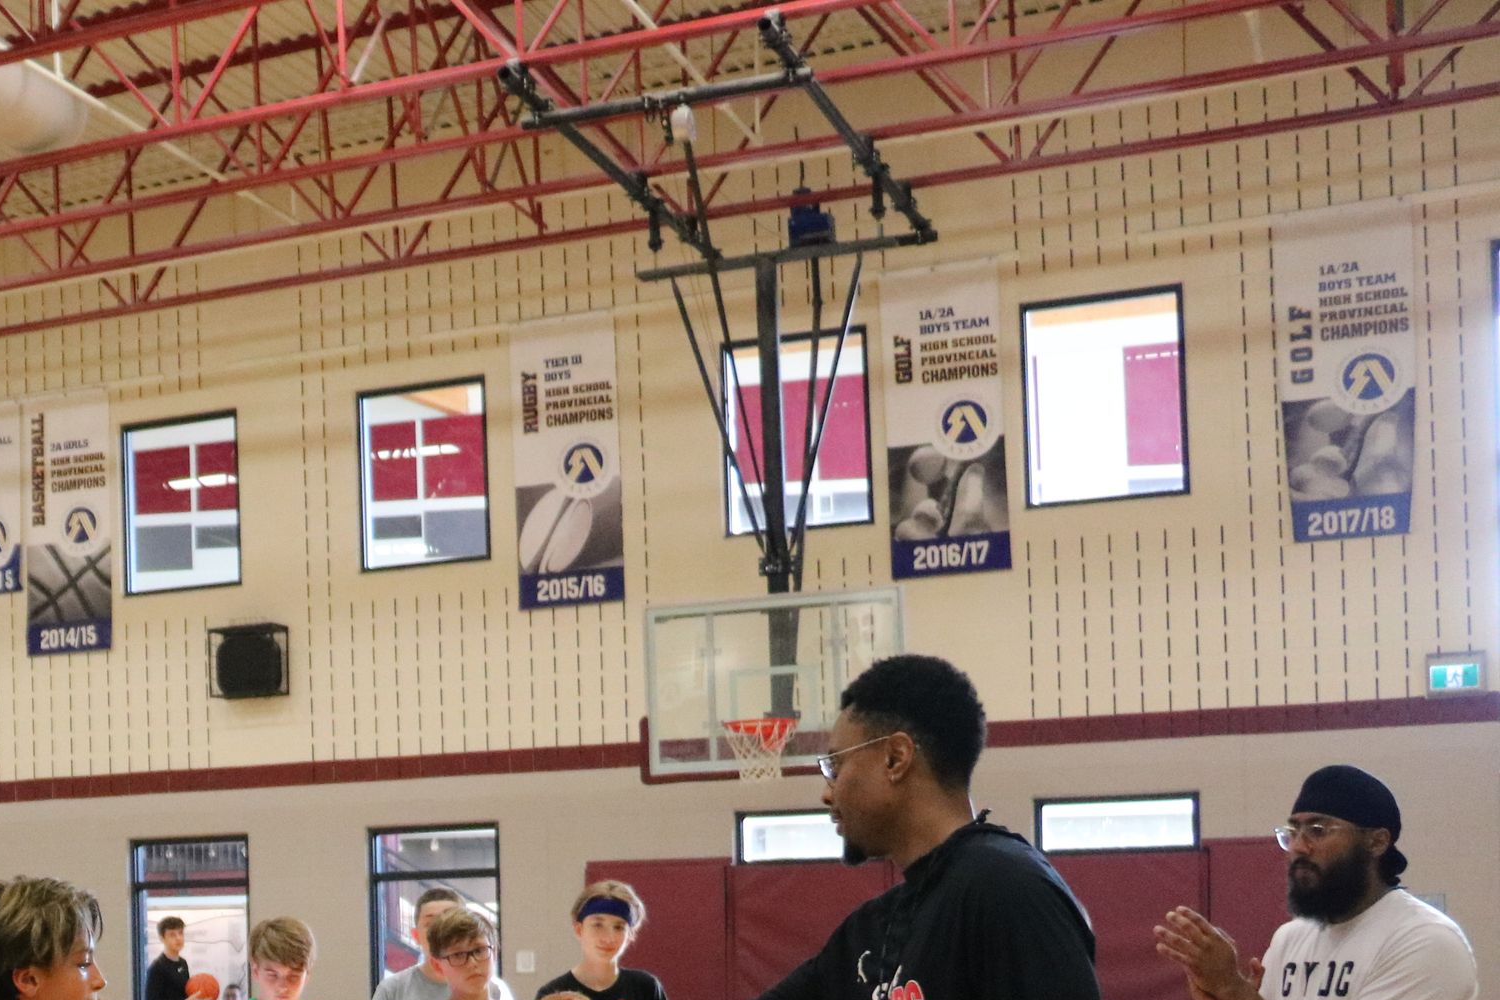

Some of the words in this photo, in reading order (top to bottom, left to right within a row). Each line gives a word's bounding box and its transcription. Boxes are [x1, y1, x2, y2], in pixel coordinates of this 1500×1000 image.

[1319, 262, 1359, 276] 1A/2A
[1318, 278, 1352, 292] BOYS
[1356, 272, 1396, 287] TEAM
[1319, 294, 1352, 308] HIGH
[1356, 287, 1408, 303] SCHOOL
[920, 307, 954, 320] 1A/2A
[1320, 302, 1408, 323] PROVINCIAL
[920, 321, 950, 335] BOYS
[955, 317, 990, 330] TEAM
[1320, 316, 1410, 342] CHAMPIONS
[920, 340, 948, 352] HIGH
[952, 334, 996, 348] SCHOOL
[1288, 306, 1314, 384] GOLF
[544, 356, 569, 368] TIER
[894, 336, 912, 384] GOLF
[921, 350, 996, 366] PROVINCIAL
[544, 370, 571, 382] BOYS
[922, 362, 998, 384] CHAMPIONS
[545, 386, 570, 398] HIGH
[572, 381, 612, 394] SCHOOL
[522, 372, 538, 434] RUGBY
[546, 396, 612, 410] PROVINCIAL
[546, 408, 614, 428] CHAMPIONS
[72, 452, 106, 464] SCHOOL
[32, 413, 45, 526] BASKETBALL
[51, 464, 105, 478] PROVINCIAL
[51, 476, 106, 493] CHAMPIONS
[1308, 506, 1395, 536] 2017/18
[914, 540, 990, 570] 2016/17
[536, 575, 605, 602] 2015/16
[40, 624, 97, 649] 2014/15
